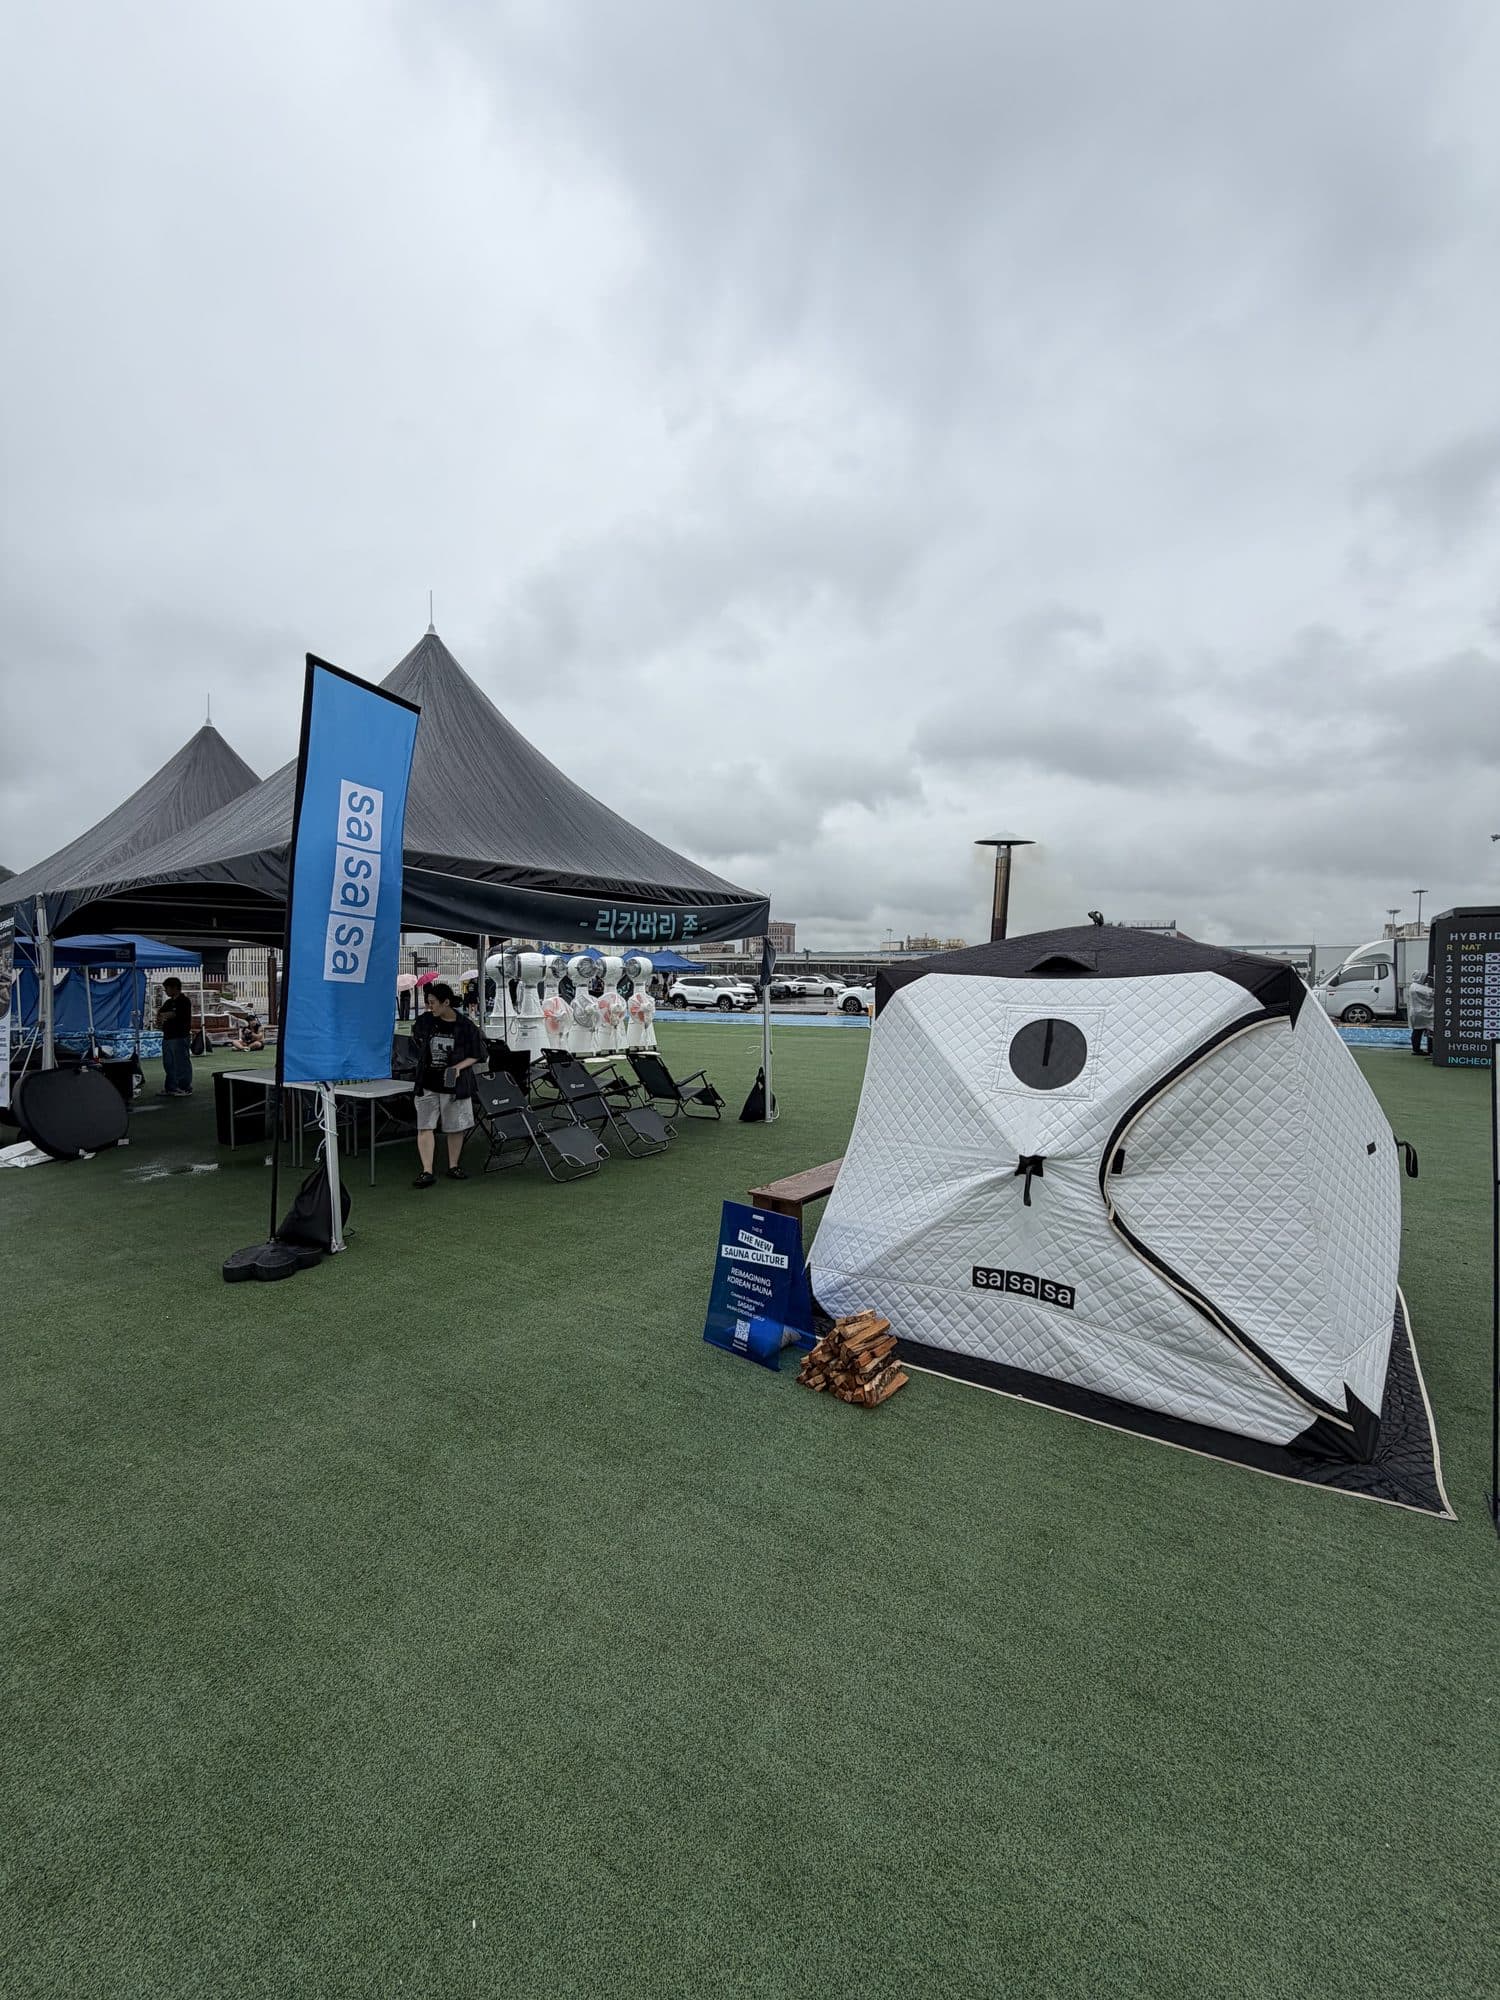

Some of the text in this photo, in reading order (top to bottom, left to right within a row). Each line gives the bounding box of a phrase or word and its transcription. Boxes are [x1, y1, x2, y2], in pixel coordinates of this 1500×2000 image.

[595, 909, 676, 940] 리커버리
[681, 914, 698, 939] 존
[1461, 943, 1481, 951] NAT
[1446, 954, 1484, 962] 1 KOR
[1446, 965, 1484, 973] 2 KOR
[1446, 976, 1484, 984] 3 KOR
[1445, 997, 1452, 1005] 5
[1444, 1008, 1452, 1016] 6
[1445, 1019, 1451, 1027] 7
[1444, 1030, 1451, 1038] 8
[1448, 1043, 1488, 1051] HYBRID
[741, 1232, 772, 1252] THE NEW
[724, 1247, 785, 1266] SAUNA CULTURE
[731, 1267, 771, 1287] REIMAGINING
[727, 1275, 773, 1297] KOREAN SAUNA
